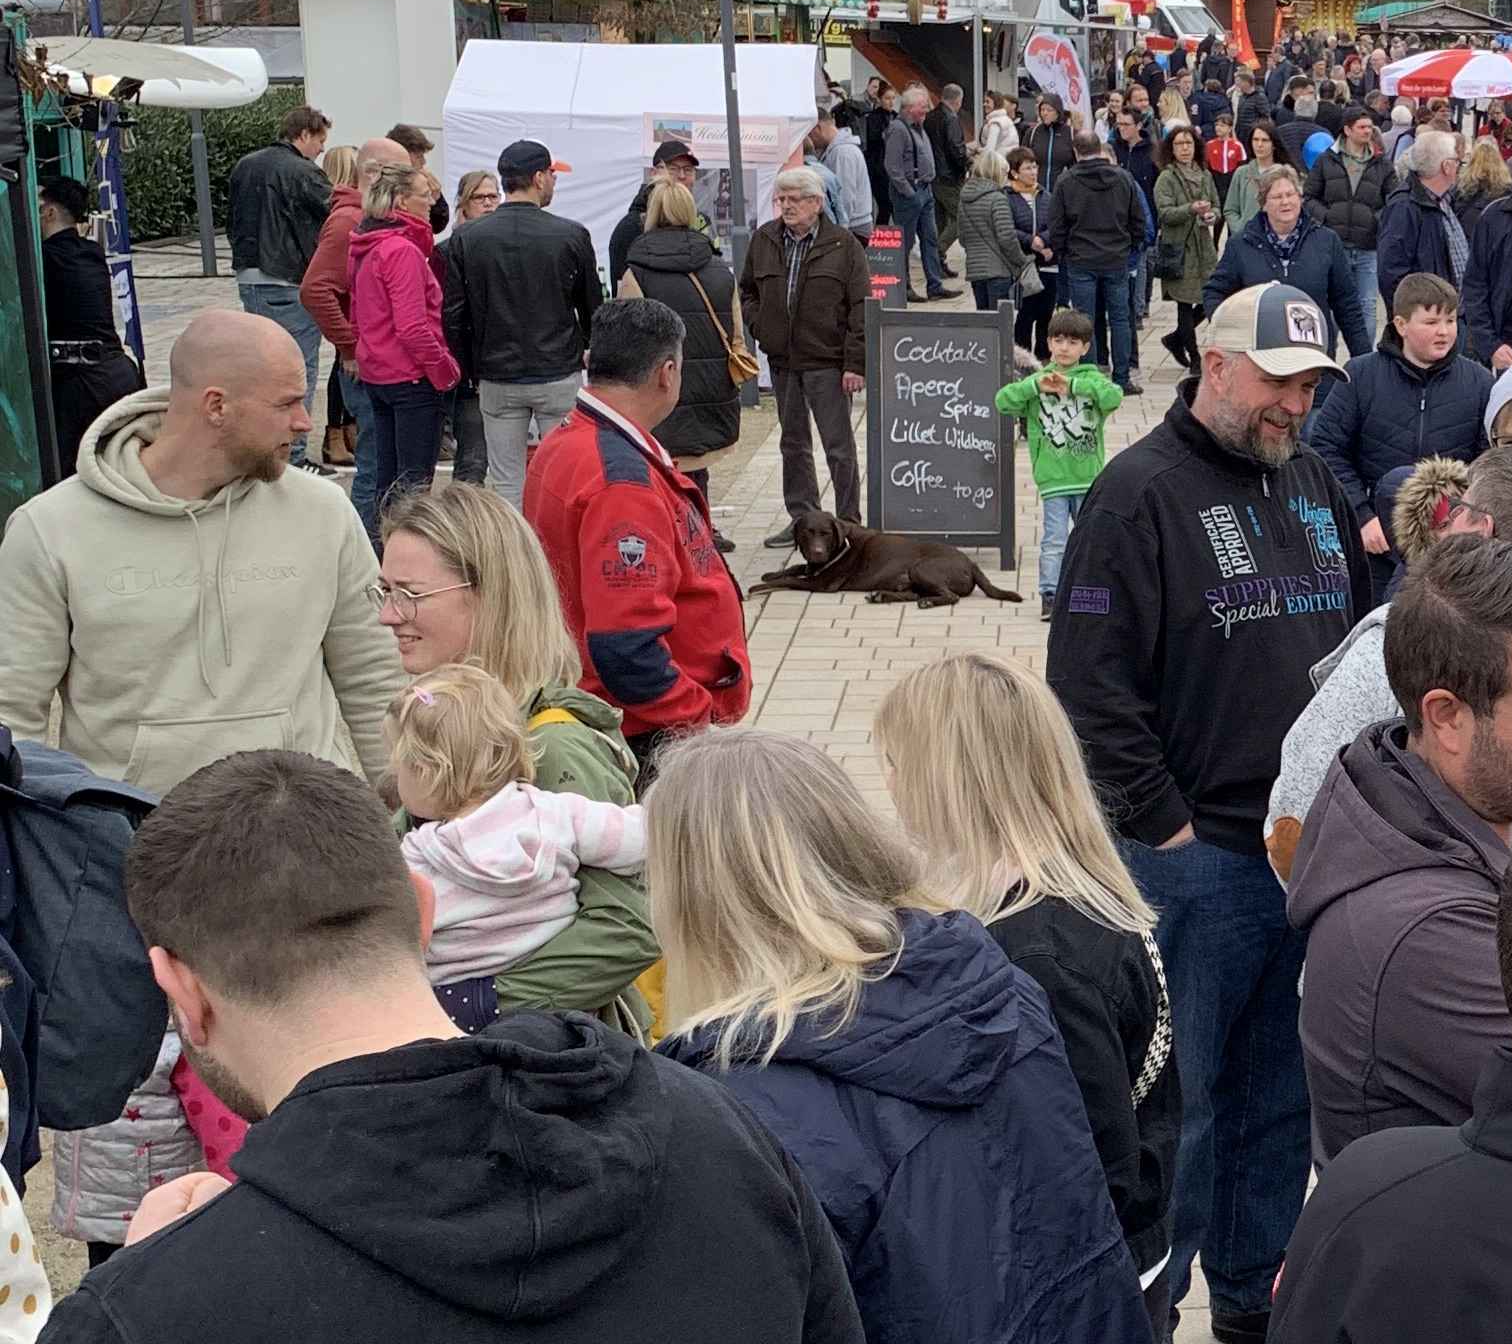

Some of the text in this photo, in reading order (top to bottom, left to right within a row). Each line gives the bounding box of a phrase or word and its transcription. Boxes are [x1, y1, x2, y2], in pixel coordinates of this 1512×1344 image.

[894, 337, 988, 363] Cocktails
[895, 372, 965, 406] Aperol
[890, 417, 944, 444] Lillet
[890, 460, 994, 509] Coffee to go
[1198, 509, 1234, 579] CERTIFICATE
[1210, 505, 1254, 575] APPROVED
[1204, 574, 1313, 607] SUPPLIES
[1210, 589, 1345, 640] Special EDITIO
